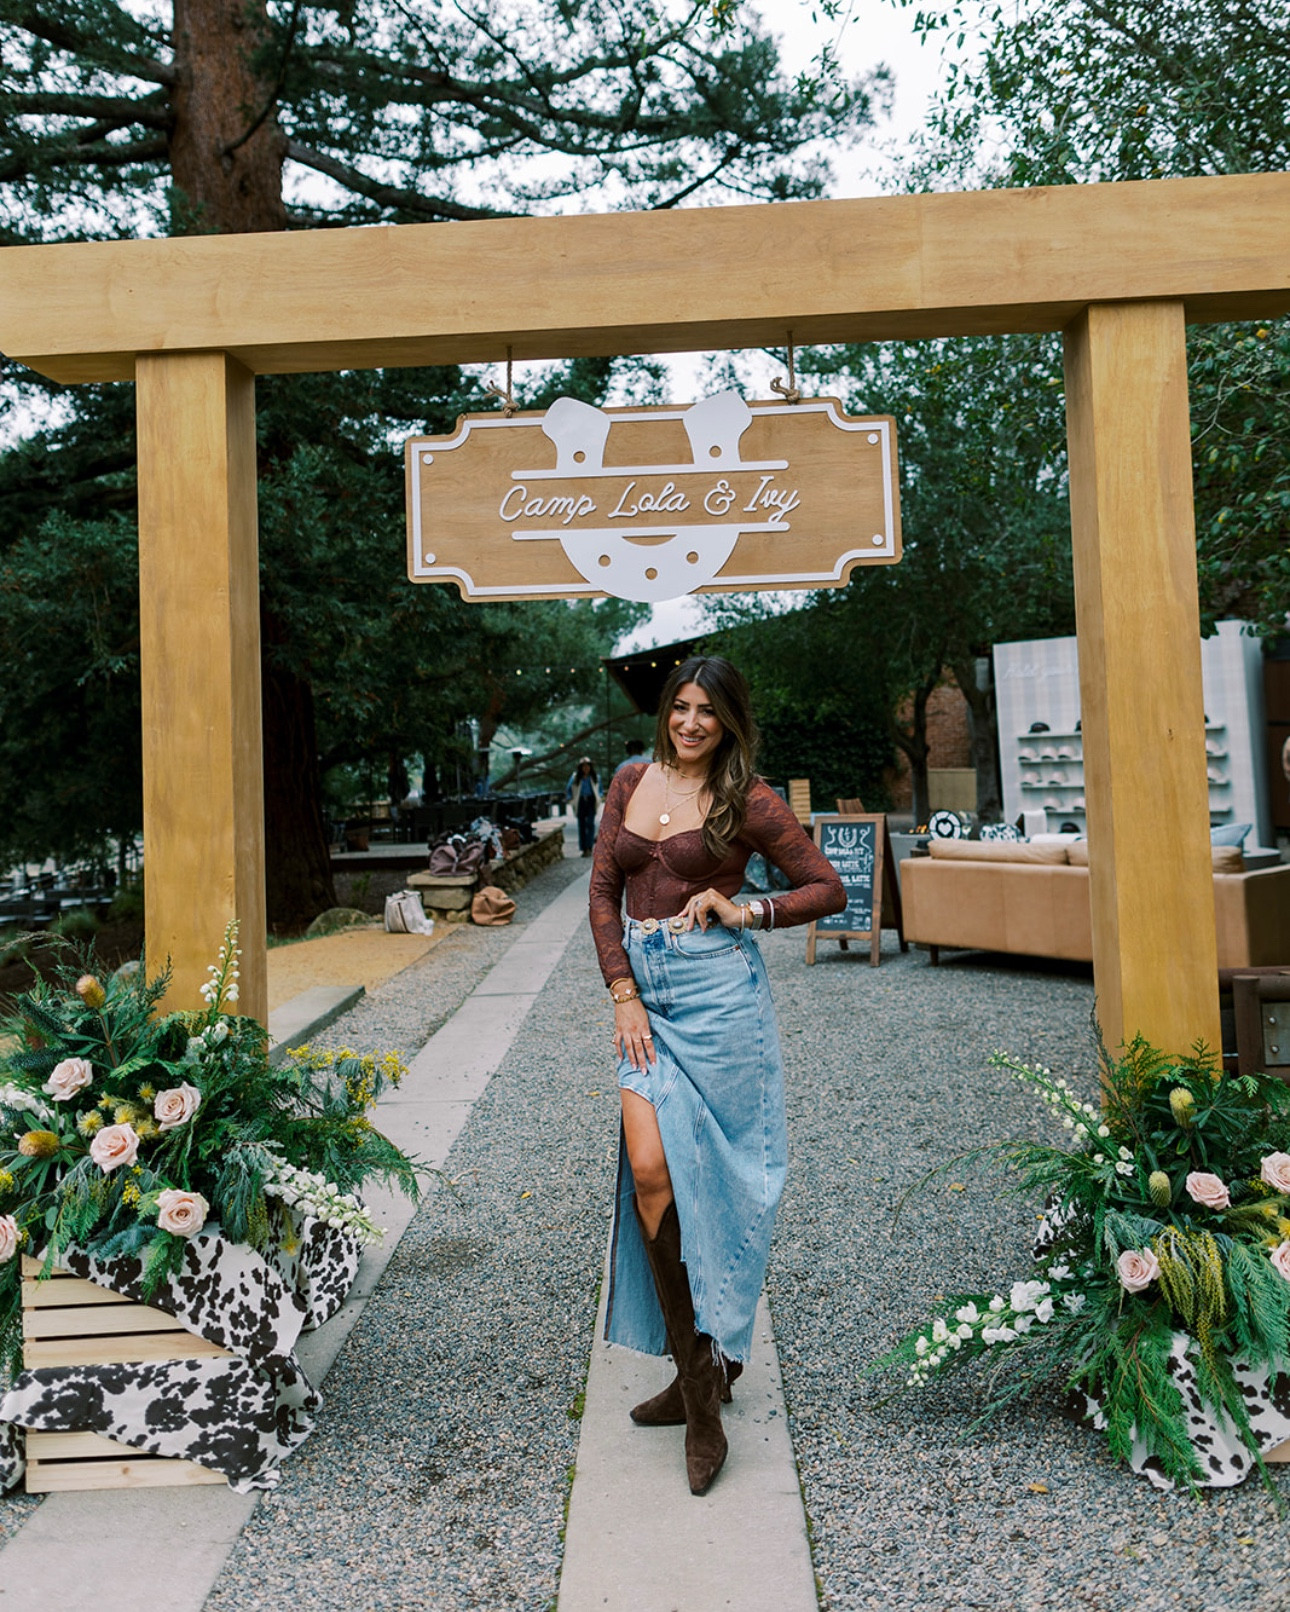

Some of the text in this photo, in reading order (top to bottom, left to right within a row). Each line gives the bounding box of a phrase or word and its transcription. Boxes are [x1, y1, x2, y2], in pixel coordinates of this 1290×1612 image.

[499, 475, 800, 525] Camp Lola & Ivy
